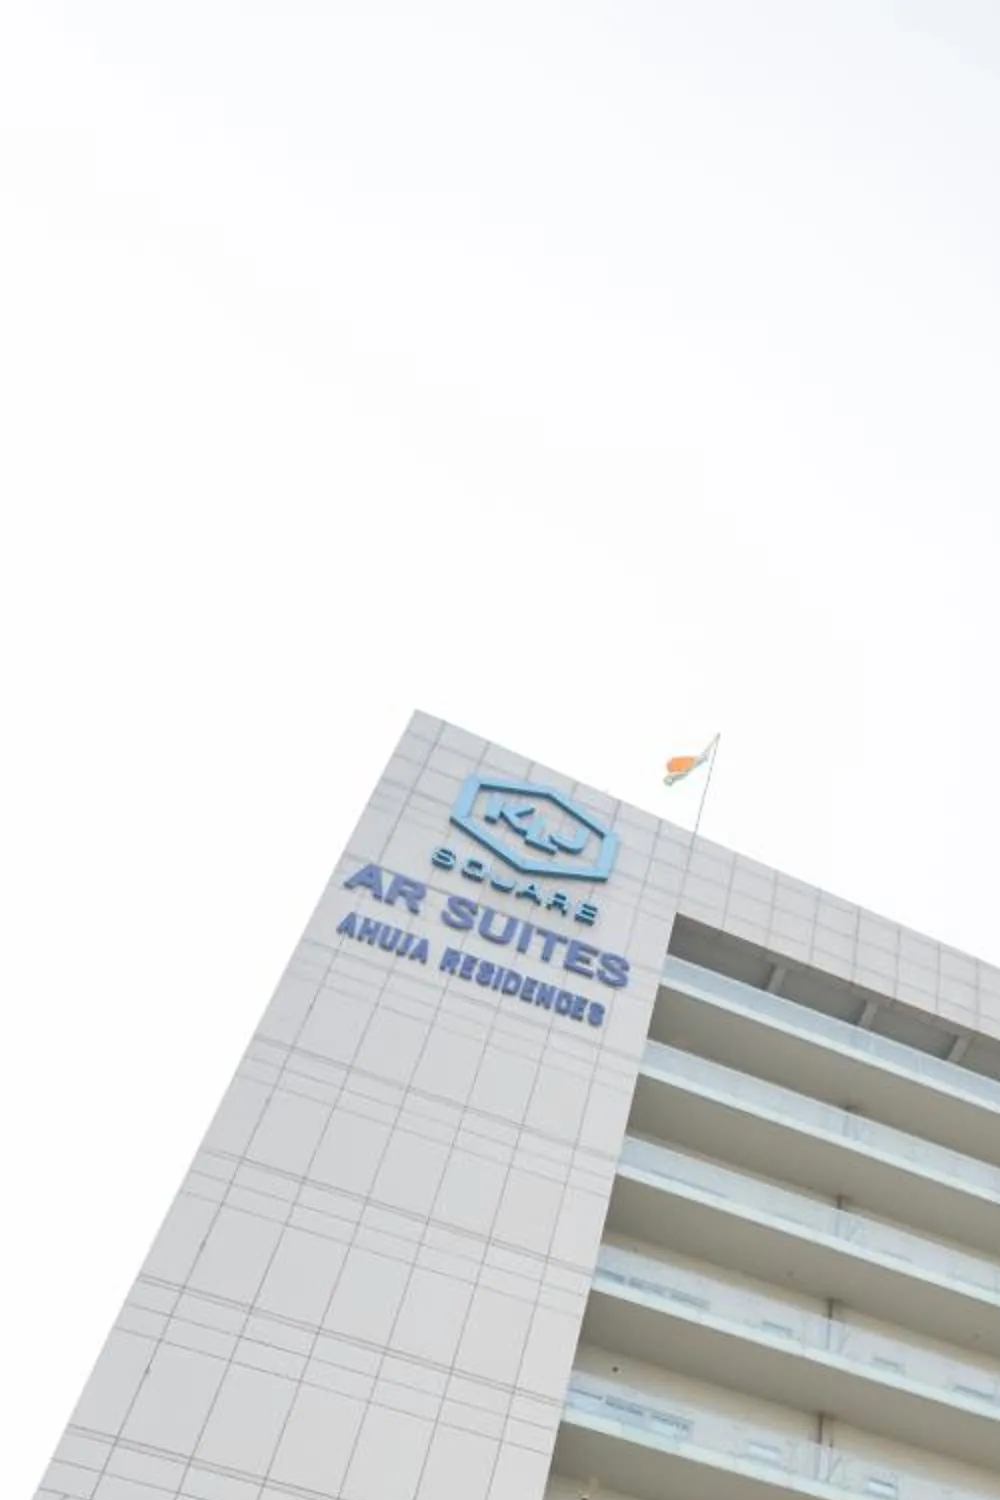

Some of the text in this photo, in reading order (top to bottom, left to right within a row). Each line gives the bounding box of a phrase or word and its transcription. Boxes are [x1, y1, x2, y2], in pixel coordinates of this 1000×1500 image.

[343, 863, 631, 989] AR SUITES
[431, 847, 598, 926] SQUARE
[336, 911, 606, 1028] AHUJA RESIDENCES
